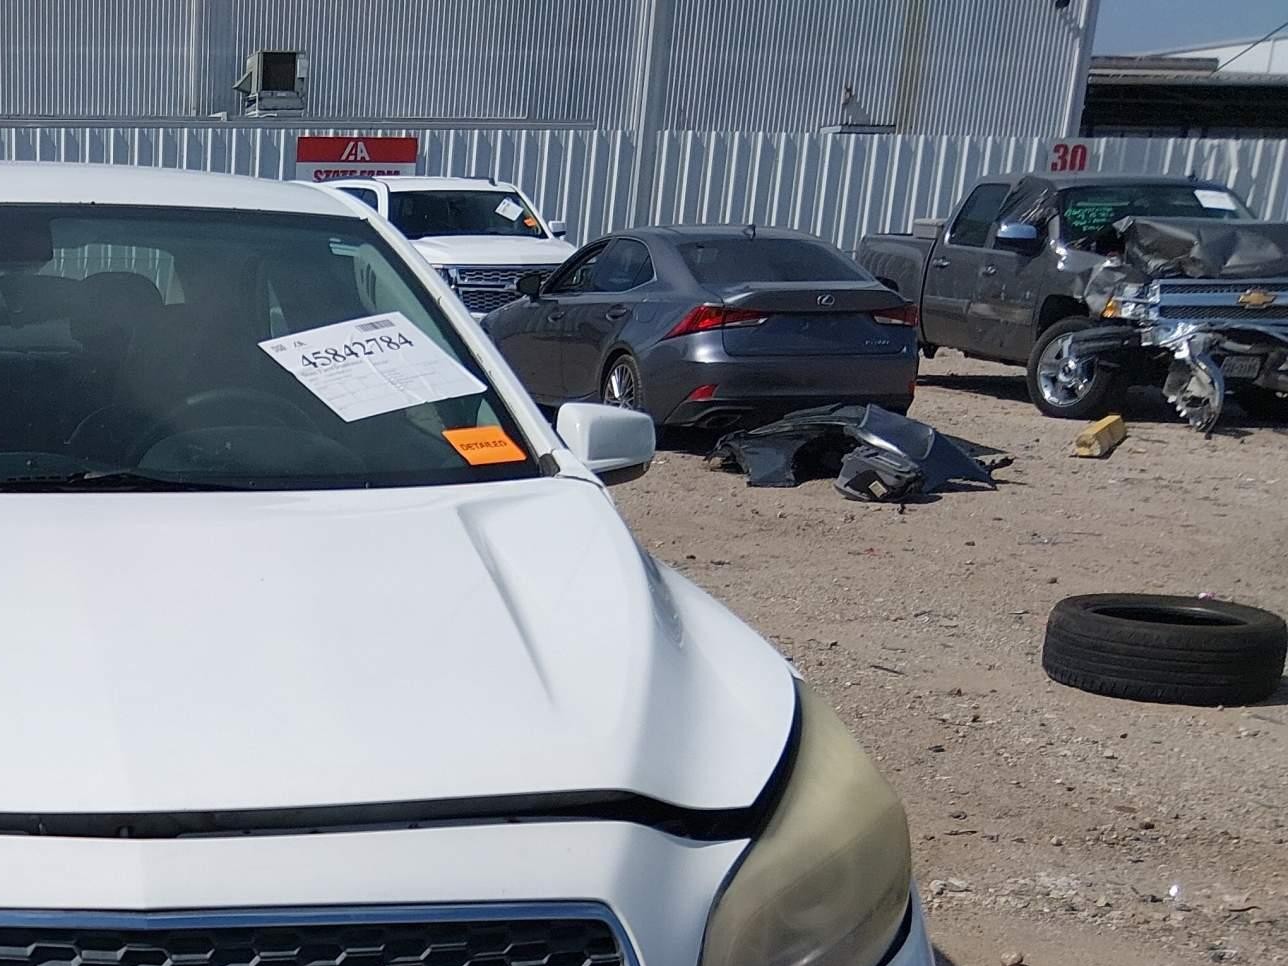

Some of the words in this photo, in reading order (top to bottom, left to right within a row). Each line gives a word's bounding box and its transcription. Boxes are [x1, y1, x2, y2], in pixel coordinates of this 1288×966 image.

[1050, 143, 1088, 172] 30
[301, 332, 414, 369] 45842784
[460, 440, 508, 452] DETAILED
